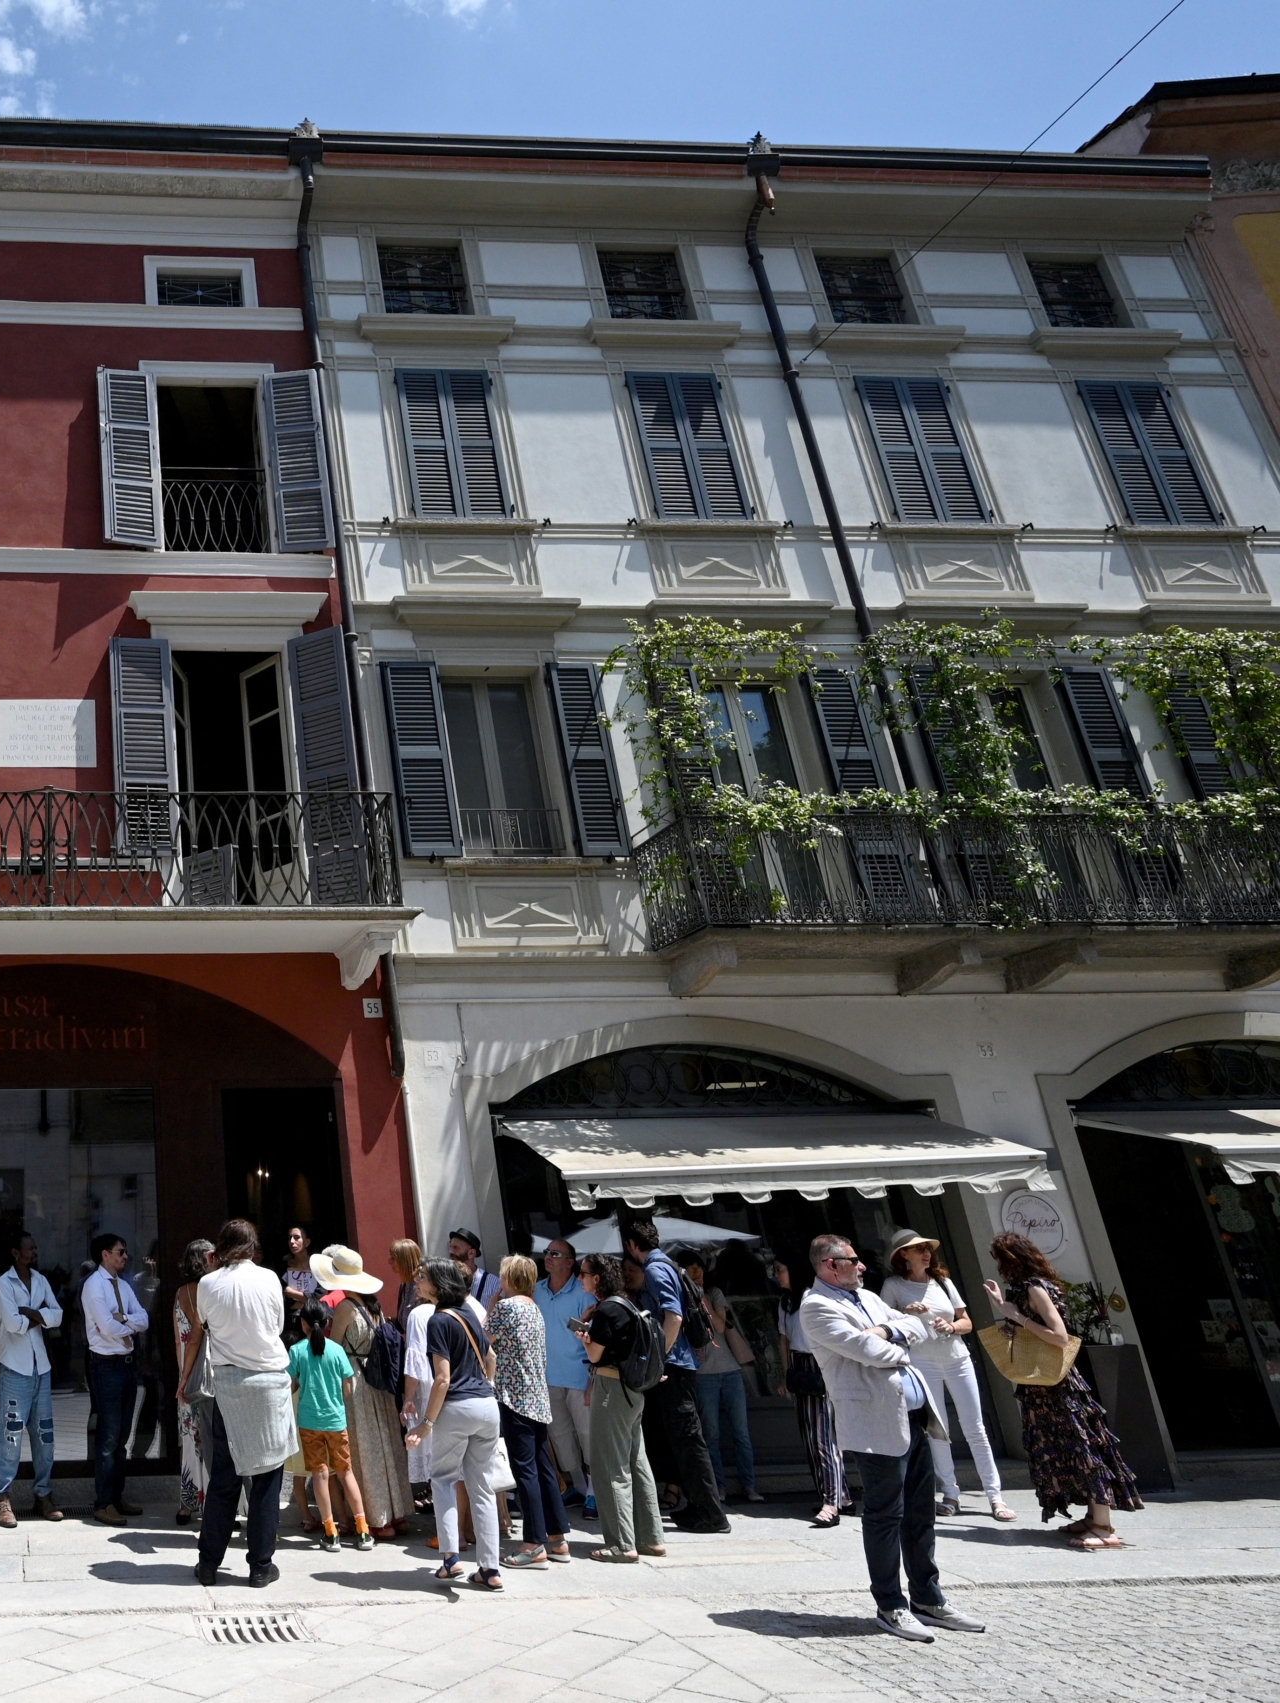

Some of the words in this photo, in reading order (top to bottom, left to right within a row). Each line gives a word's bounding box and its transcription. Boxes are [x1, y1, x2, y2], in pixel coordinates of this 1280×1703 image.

[366, 1002, 379, 1014] 55
[426, 1050, 439, 1062] 53
[980, 1046, 994, 1056] 53
[1006, 1211, 1056, 1238] Papiro
